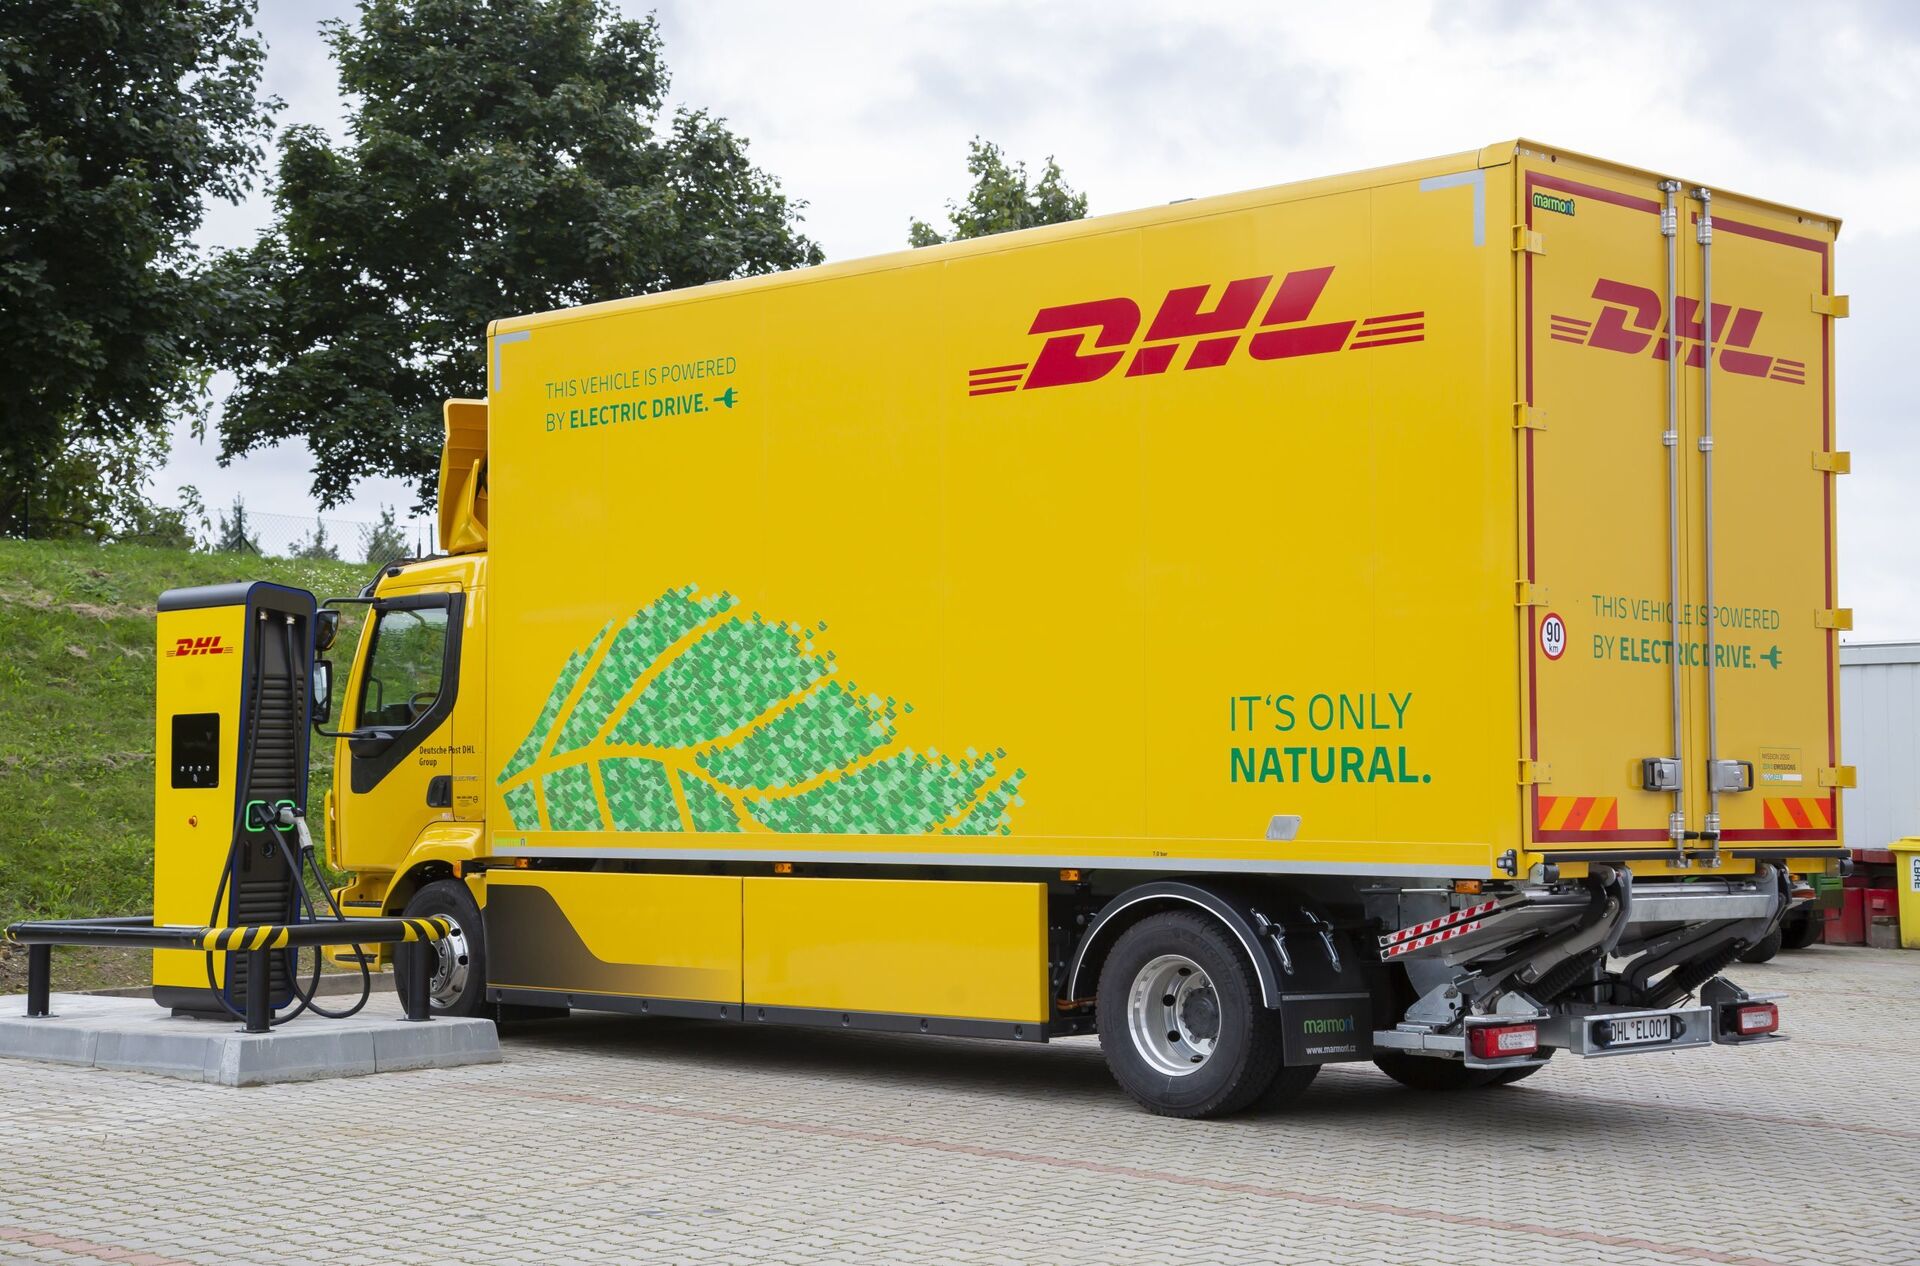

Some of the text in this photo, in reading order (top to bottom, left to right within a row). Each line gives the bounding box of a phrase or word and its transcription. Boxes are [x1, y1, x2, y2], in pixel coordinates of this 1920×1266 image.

[1533, 193, 1575, 216] marmont
[1022, 265, 1357, 390] DHL
[1588, 278, 1773, 378] DHL
[545, 356, 737, 399] THIS VEHICLE IS POWERED
[546, 393, 709, 432] BY ELECTRIC DRIVE.
[1592, 594, 1627, 619] THIS
[1631, 598, 1692, 625] VEHICE
[1695, 604, 1709, 626] IS
[1546, 621, 1560, 643] 90
[175, 636, 224, 656] DHL
[1548, 644, 1559, 652] km
[1593, 634, 1615, 659] BY
[1308, 692, 1413, 731] ONLY
[419, 745, 476, 755] Deutsche Post DHL
[419, 757, 438, 767] Group
[1230, 745, 1432, 784] NATURAL.
[1303, 1014, 1354, 1034] marmont
[1610, 1018, 1668, 1042] DHL EL001
[1305, 1043, 1357, 1055] www.marmont.cz
